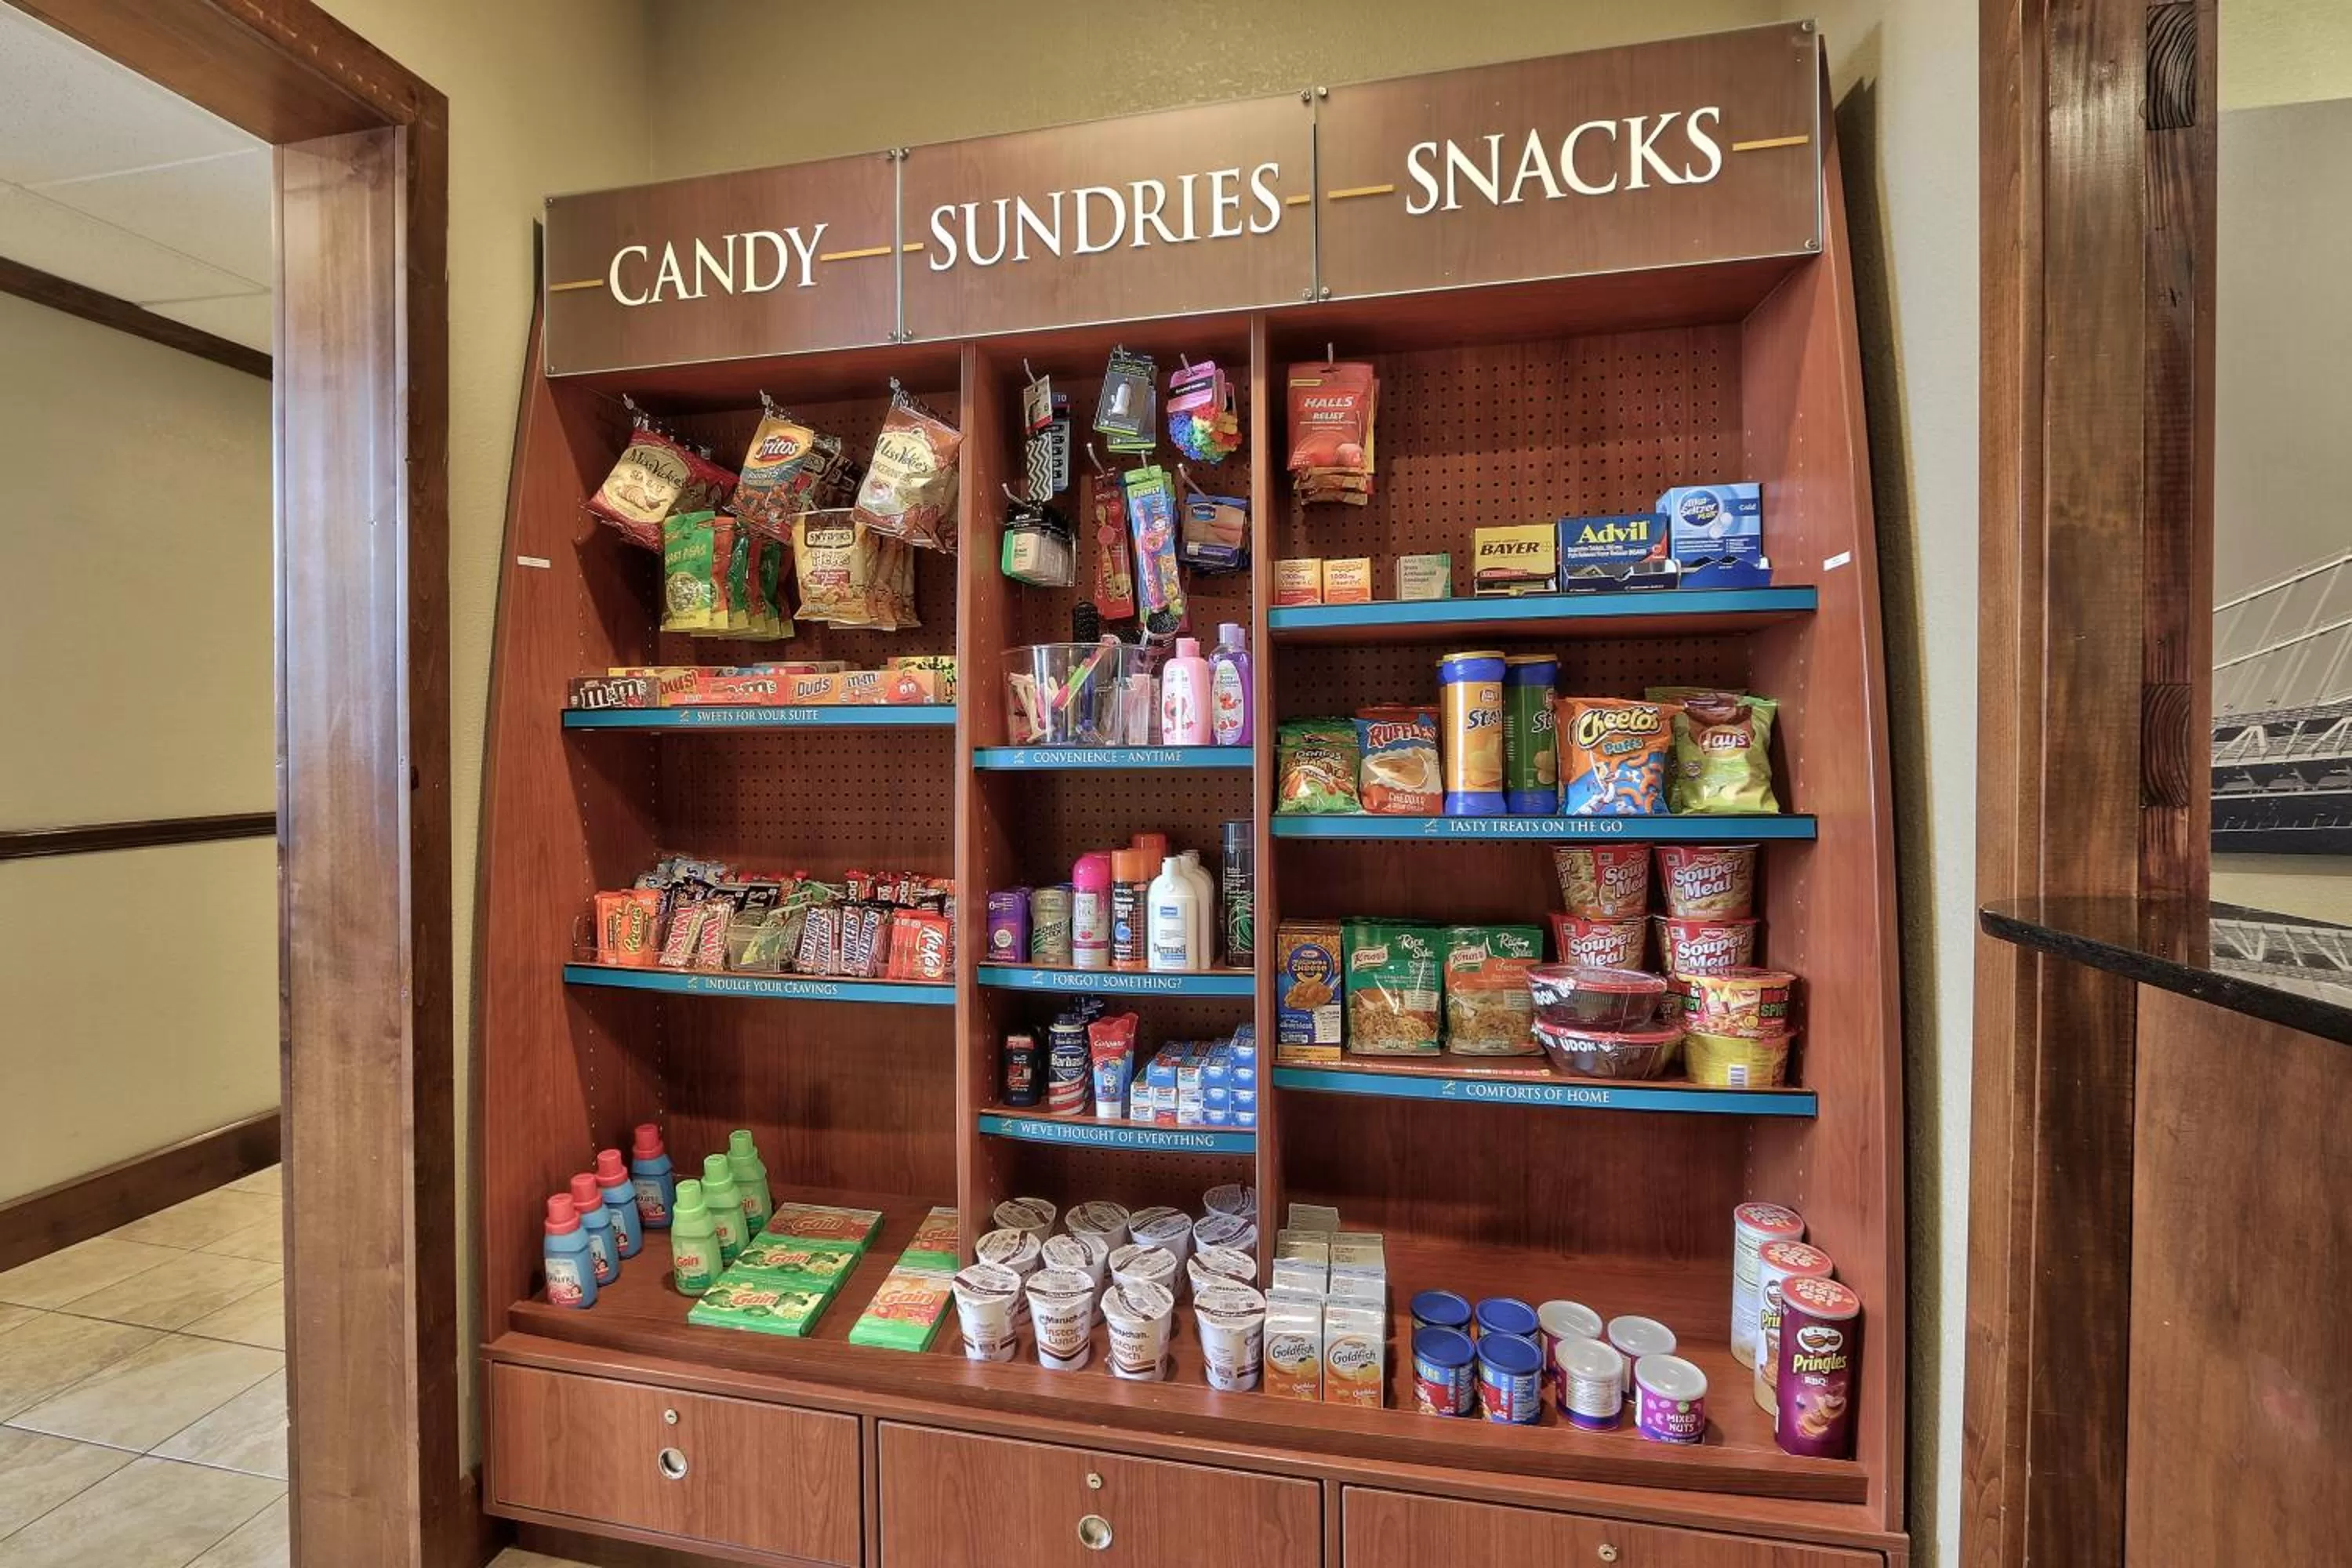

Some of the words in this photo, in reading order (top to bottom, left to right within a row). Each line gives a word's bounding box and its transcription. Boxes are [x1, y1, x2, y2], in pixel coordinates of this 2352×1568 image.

[1406, 106, 1723, 216] SNACKS
[929, 162, 1282, 271] SUNDRIES
[608, 223, 828, 307] CANDY
[1304, 396, 1355, 408] HALLS
[755, 436, 799, 459] Fritos
[1575, 521, 1648, 544] Advil
[1479, 542, 1541, 556] BAYER
[797, 677, 832, 697] Duds
[697, 709, 733, 722] SWEETS
[736, 709, 757, 721] FOR
[758, 709, 786, 721] YOUR
[789, 709, 818, 720] SUITE
[1367, 722, 1436, 749] RUFFLES
[1576, 707, 1661, 748] Cheetos
[1602, 738, 1644, 754] Puffs
[1033, 751, 1117, 763] CONVENIENCE
[1128, 750, 1183, 762] ANYTIME
[1450, 821, 1488, 833] TASTY
[1498, 821, 1539, 832] TREATS
[1543, 821, 1566, 832] ON
[1570, 821, 1598, 832] THE
[1599, 821, 1623, 832] GO
[1673, 858, 1744, 887] Souper
[1683, 873, 1733, 901] Meal
[800, 906, 820, 960] SNICKERS
[858, 910, 880, 967] SNICKERS
[1570, 930, 1635, 956] Souper
[1678, 932, 1747, 959] Souper
[1580, 944, 1627, 967] Meal
[1688, 948, 1736, 967] Meal
[706, 978, 750, 992] INDULGE
[753, 980, 782, 993] YOUR
[784, 981, 839, 996] CRAVINGS
[1052, 974, 1098, 986] FORGOT
[1103, 976, 1182, 989] SOMETHING?
[1559, 1037, 1597, 1052] UDON
[1466, 1084, 1541, 1100] COMFORTS
[1544, 1087, 1564, 1101] OF
[1566, 1089, 1610, 1103] HOME
[1021, 1123, 1055, 1136] WE'VE
[1058, 1125, 1117, 1141] THOUGHT
[1120, 1131, 1134, 1142] OF
[1137, 1132, 1214, 1147] EVERYTHING
[677, 1257, 699, 1268] Gain
[765, 1254, 809, 1264] Gain
[732, 1294, 779, 1305] Gain
[881, 1293, 933, 1305] Gain
[1272, 1343, 1316, 1359] Goldfish
[1332, 1351, 1377, 1365] Goldfish
[1793, 1353, 1847, 1374] Pringles
[1804, 1376, 1827, 1386] BBQ
[1666, 1413, 1697, 1424] MIXED
[1668, 1423, 1695, 1432] NUTS
